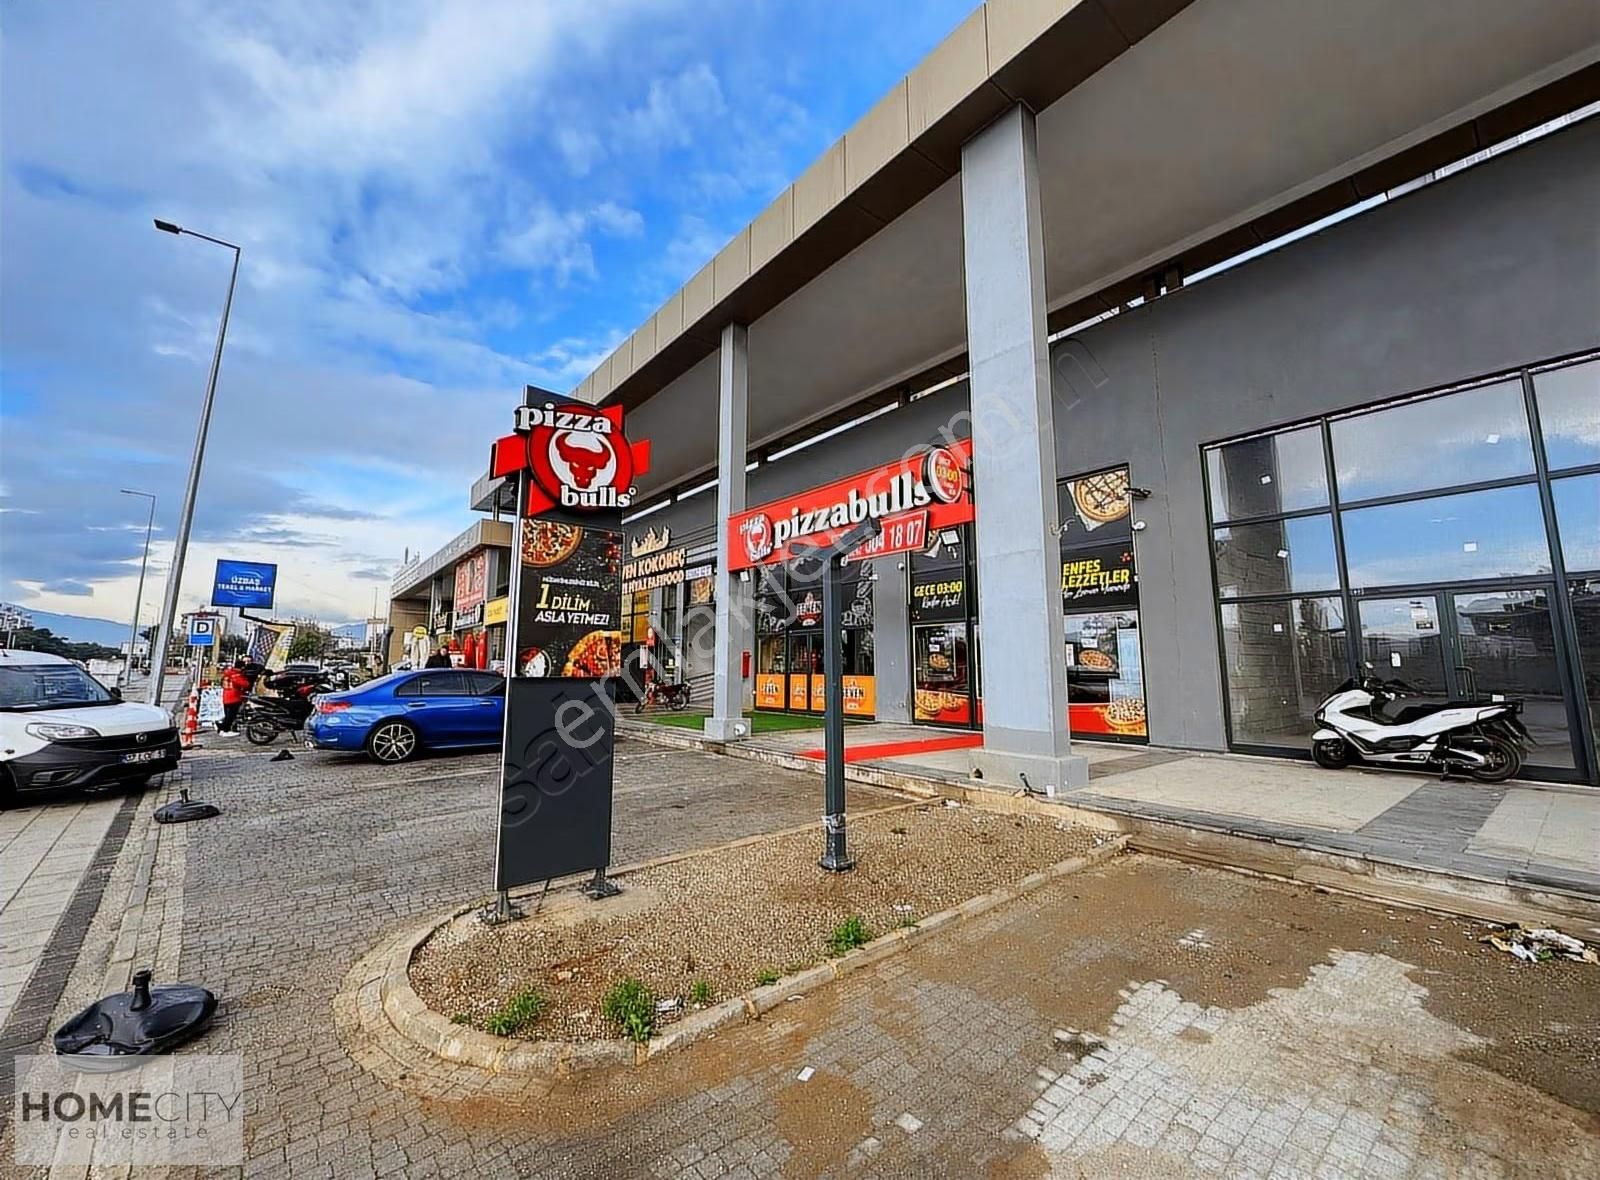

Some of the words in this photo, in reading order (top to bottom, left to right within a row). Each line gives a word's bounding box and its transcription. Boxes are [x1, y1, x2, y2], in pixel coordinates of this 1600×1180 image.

[518, 403, 612, 433] pizza
[561, 485, 632, 507] bulls
[773, 471, 931, 549] pizzabulls
[890, 524, 903, 549] 18
[907, 519, 922, 545] 07
[638, 548, 686, 577] KOKOREÇ
[1063, 559, 1101, 576] ENFES
[914, 583, 936, 597] GECE
[937, 581, 963, 594] 03:00
[1062, 569, 1130, 590] LEZZETLER
[536, 584, 549, 609] 1
[551, 593, 591, 611] DİLİM
[196, 622, 210, 634] D
[534, 610, 565, 623] ASLA
[567, 612, 610, 626] YETMEZ!
